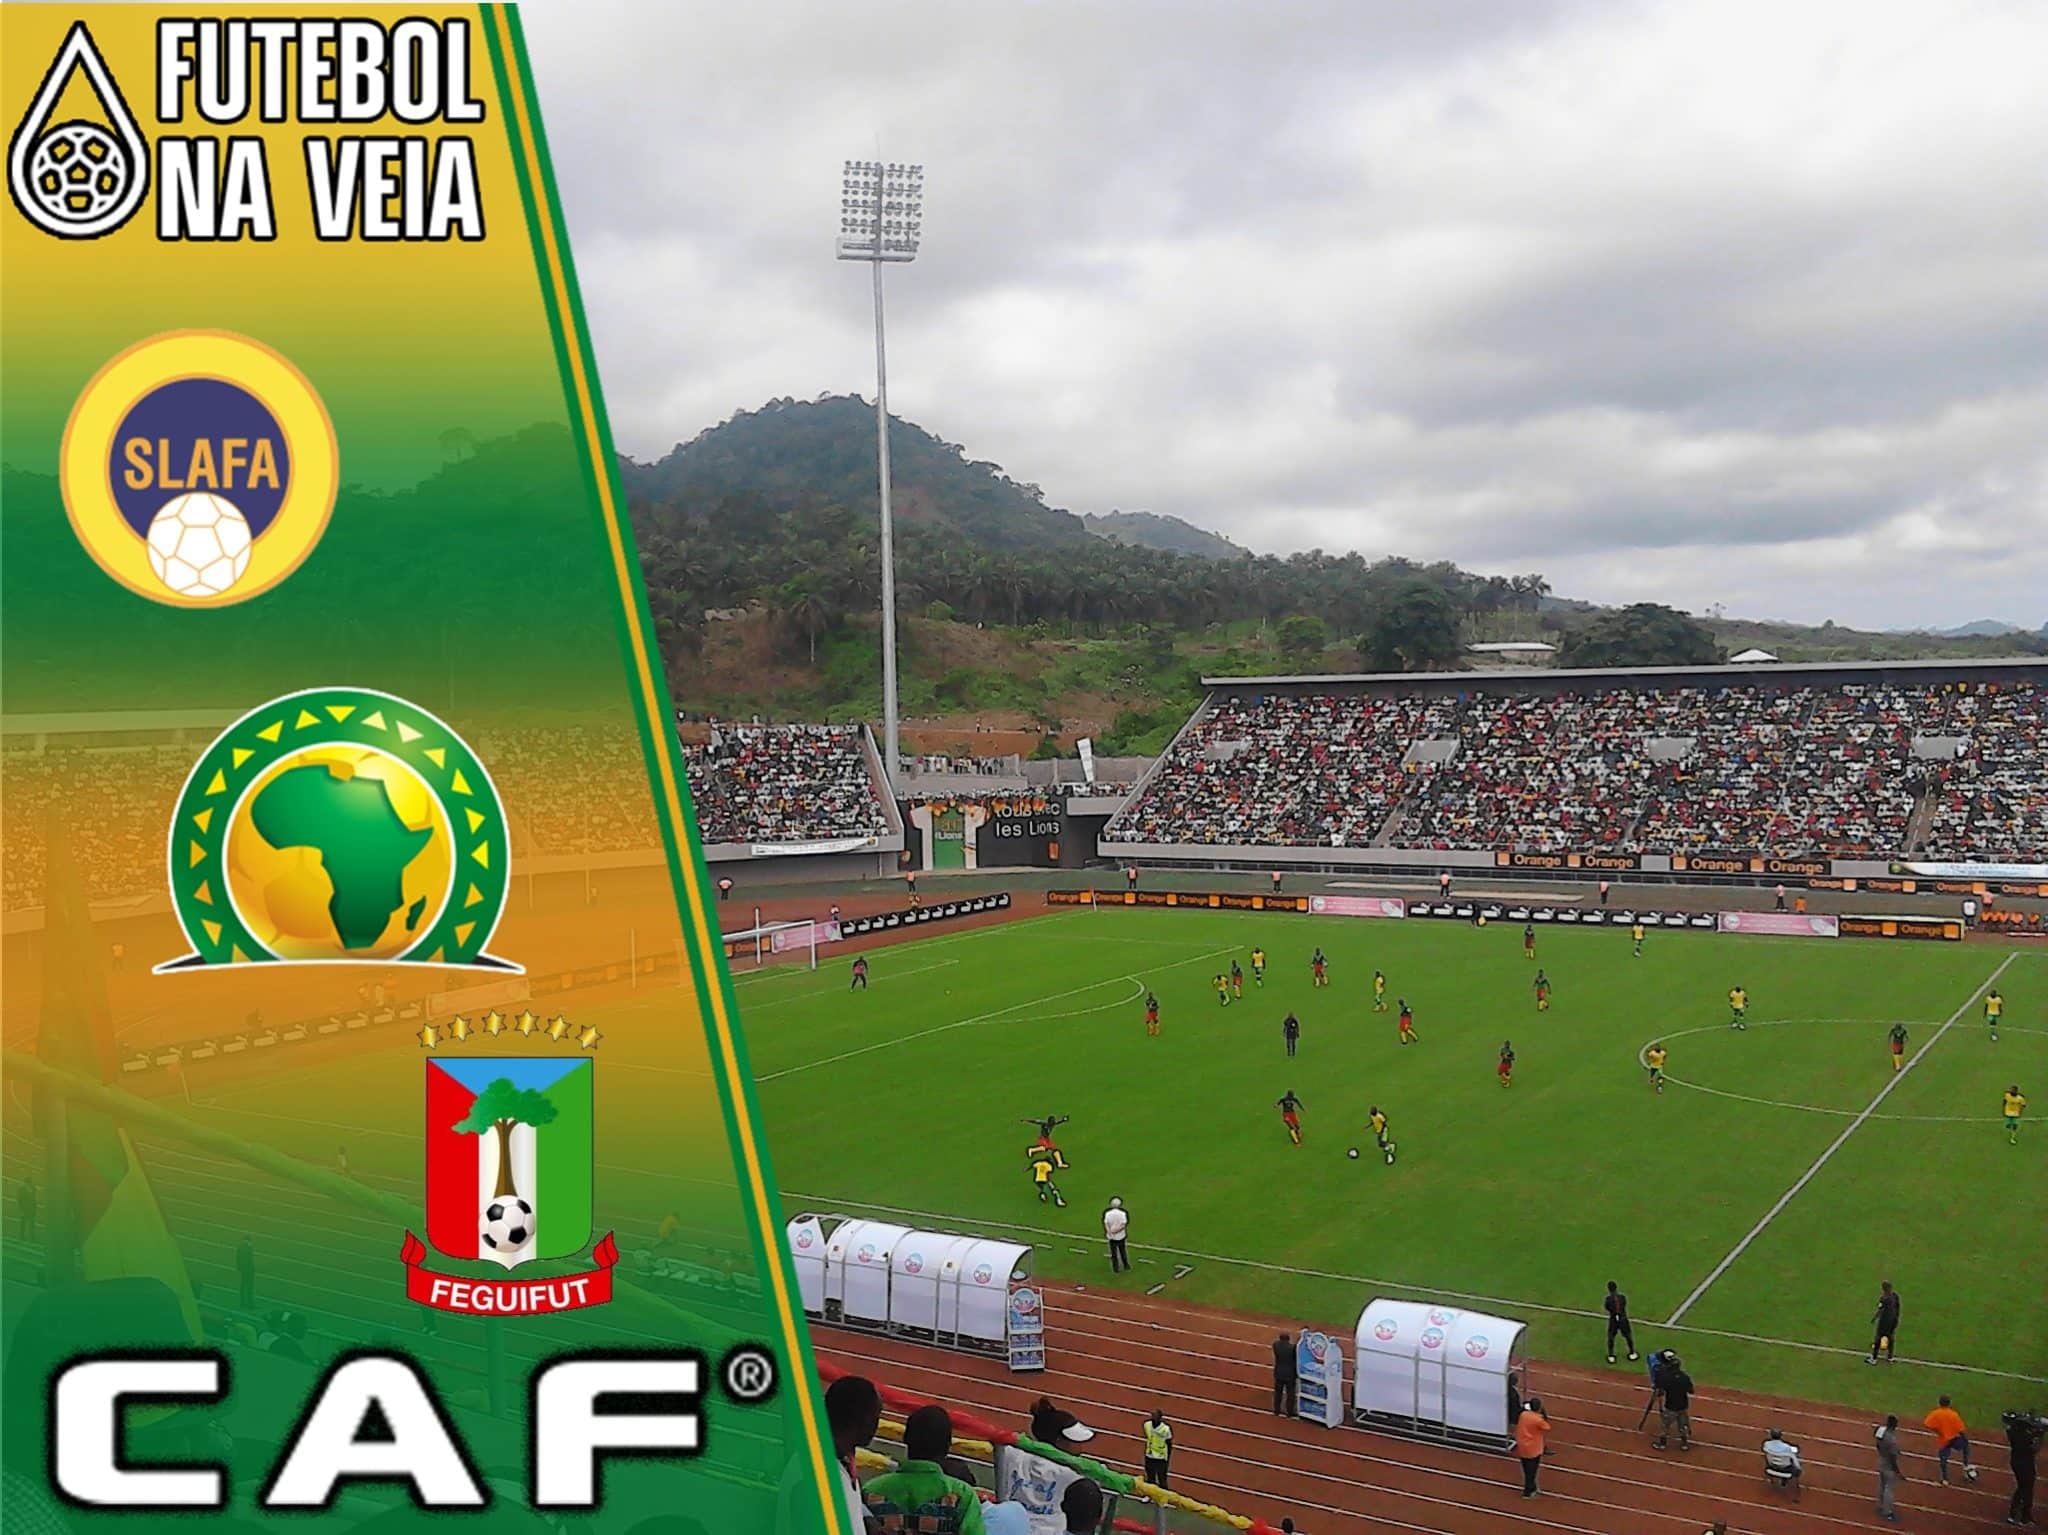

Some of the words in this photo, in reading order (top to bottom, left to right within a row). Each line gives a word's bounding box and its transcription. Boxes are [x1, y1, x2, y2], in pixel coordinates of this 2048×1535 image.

[996, 822, 1022, 837] les
[1029, 820, 1060, 836] Lions
[1513, 854, 1562, 867] Orange
[1585, 855, 1635, 870] Orange
[1691, 857, 1744, 873] Orange
[1769, 859, 1824, 876] Orange
[1900, 922, 1944, 937] Orange
